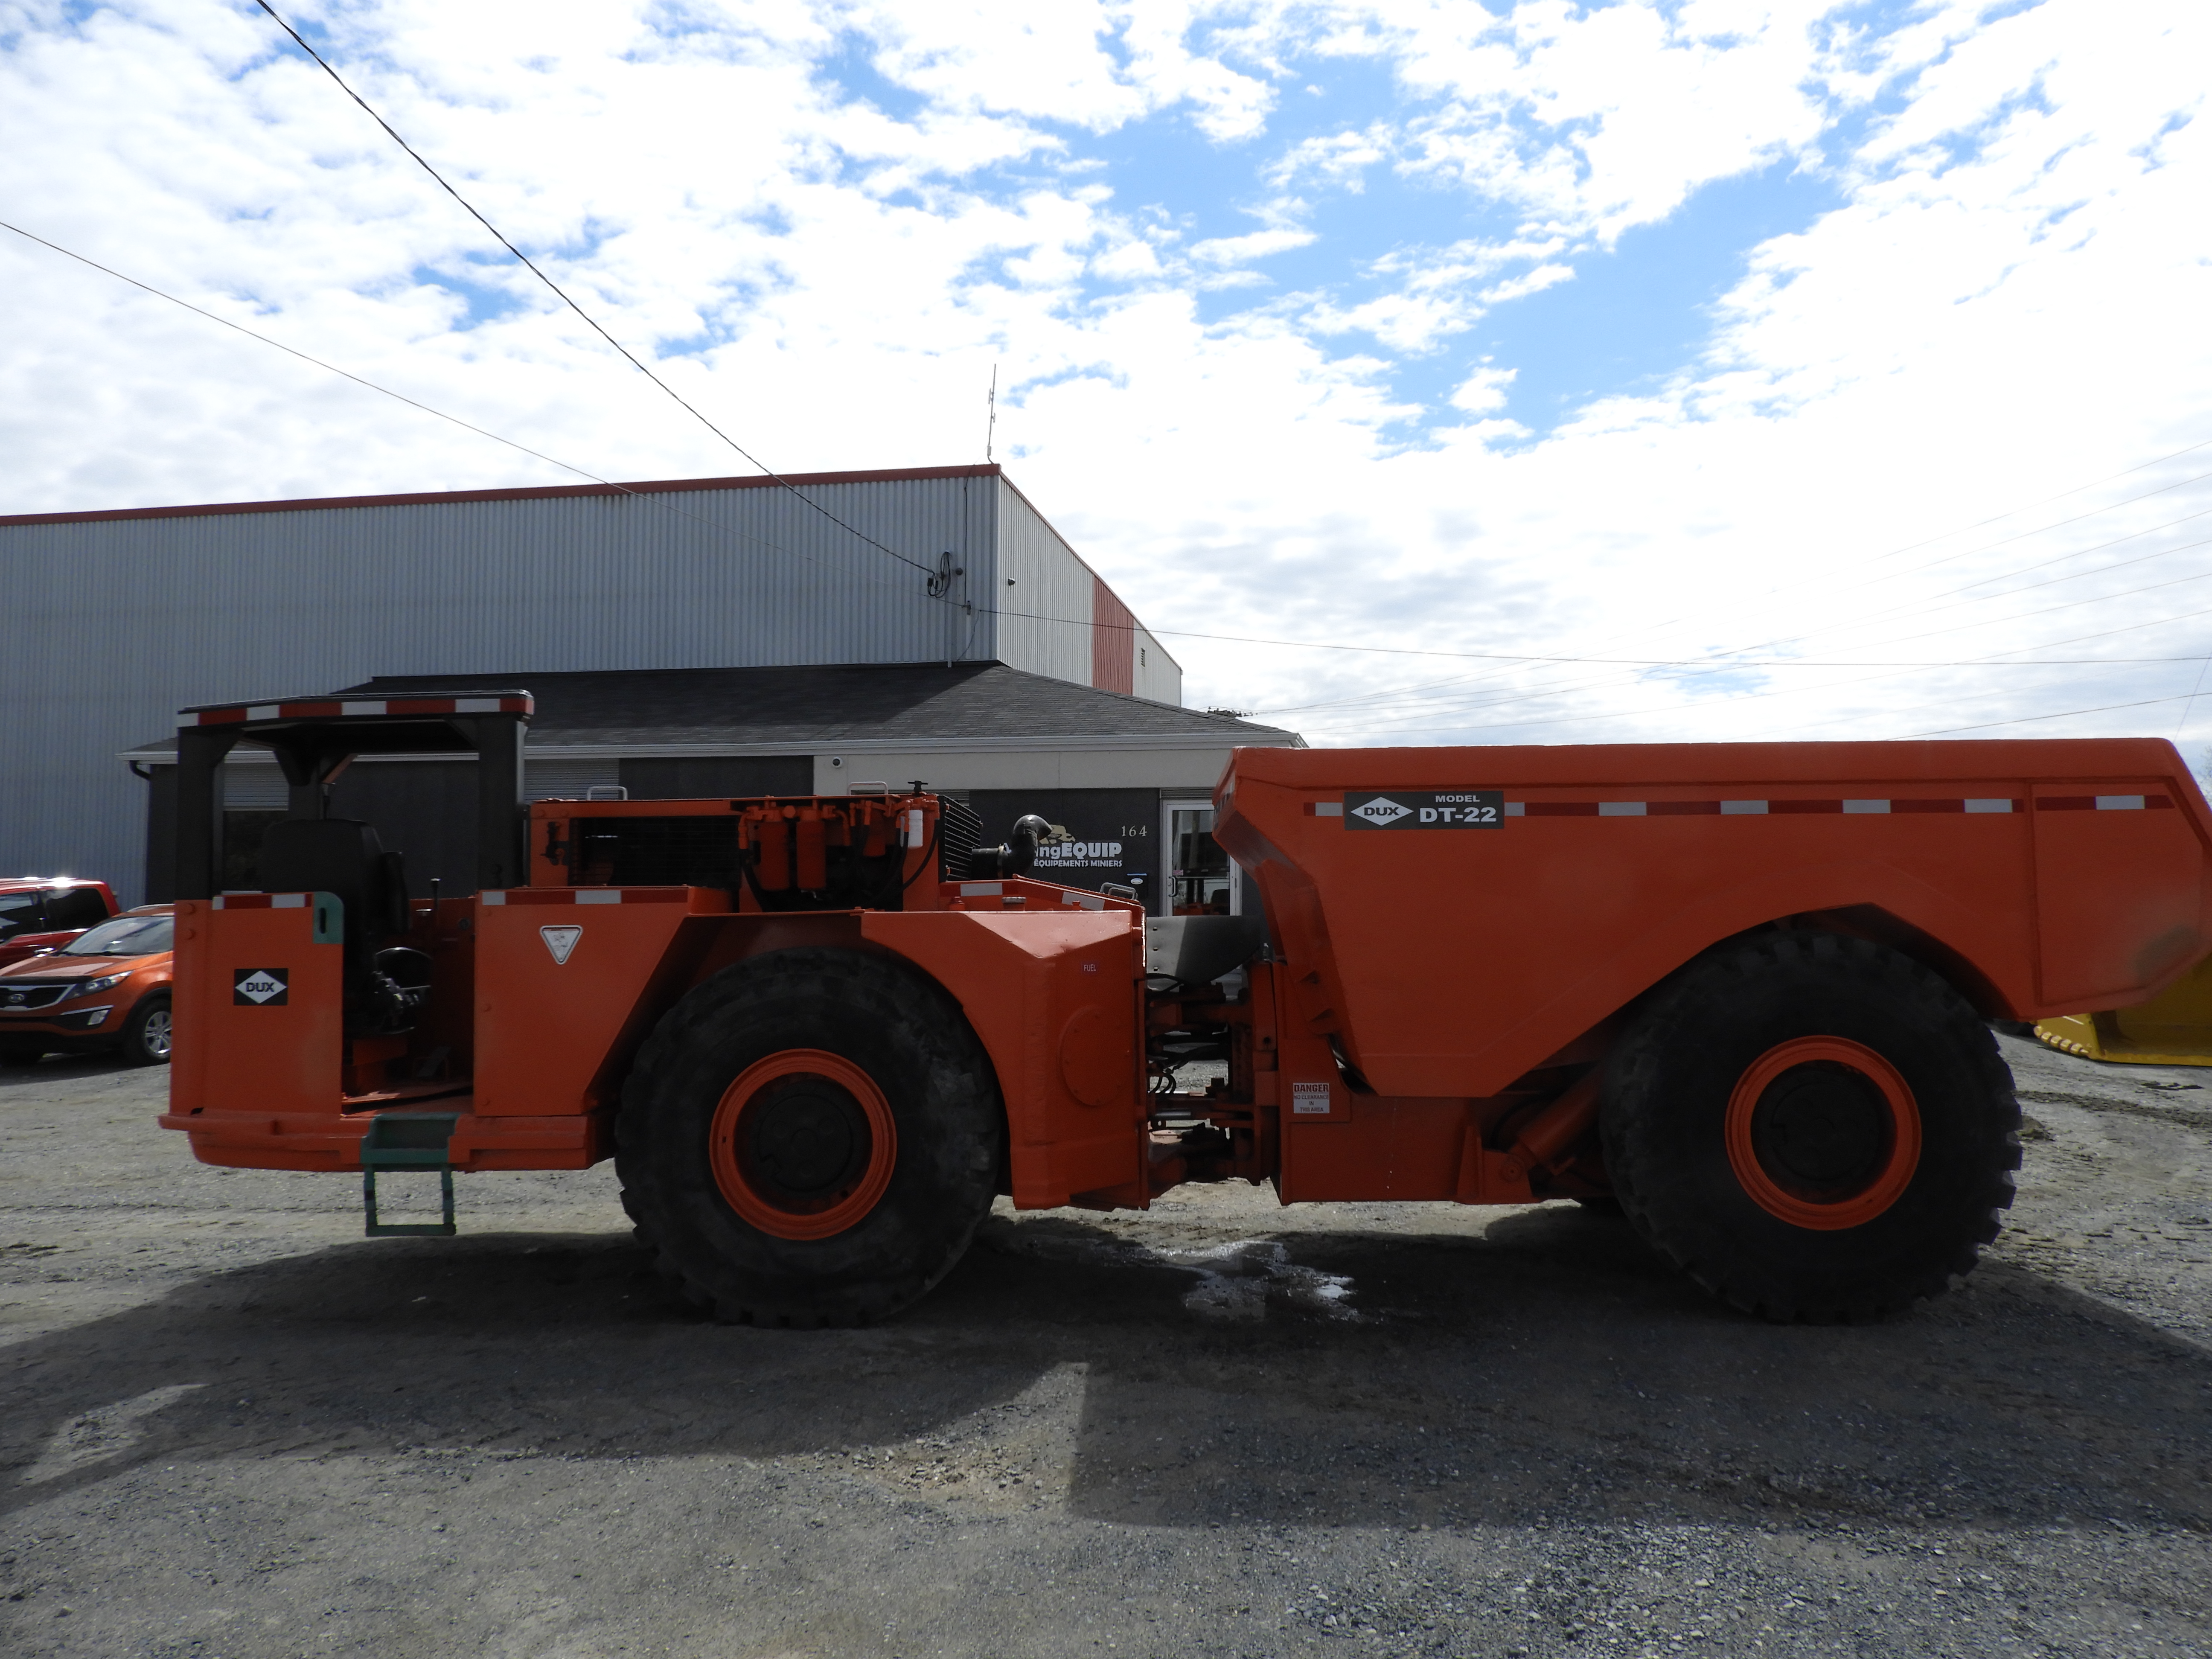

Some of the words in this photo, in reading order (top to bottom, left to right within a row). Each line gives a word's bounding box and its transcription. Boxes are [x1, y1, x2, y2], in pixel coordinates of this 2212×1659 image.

[1363, 807, 1400, 816] DUX
[1419, 807, 1496, 823] DT-22
[1122, 826, 1147, 836] 164
[1034, 859, 1088, 868] ÉQUIPEMENTS
[246, 982, 275, 992] DUX
